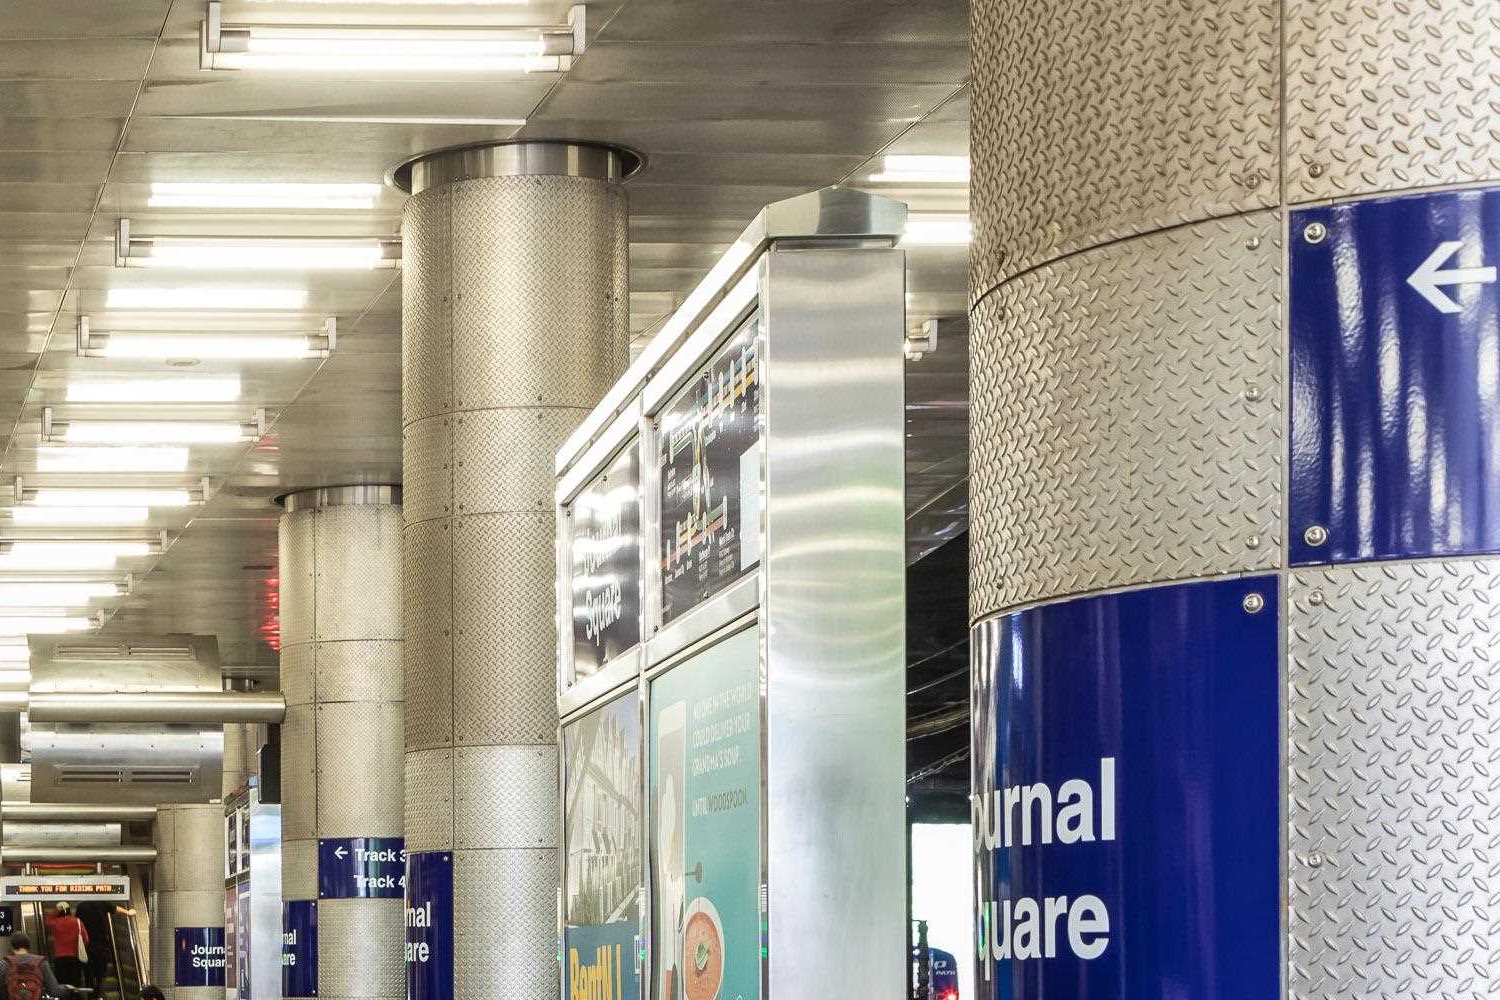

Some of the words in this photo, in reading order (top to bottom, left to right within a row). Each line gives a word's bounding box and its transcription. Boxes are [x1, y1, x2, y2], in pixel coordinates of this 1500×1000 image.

[586, 579, 622, 647] Square
[973, 757, 1116, 851] ournal
[355, 848, 396, 862] Track
[354, 875, 394, 888] Track
[19, 885, 37, 893] THANK
[0, 911, 5, 919] 3
[0, 924, 5, 932] 4
[978, 894, 1110, 980] quare
[191, 944, 226, 955] Journ
[192, 957, 226, 970] Squar
